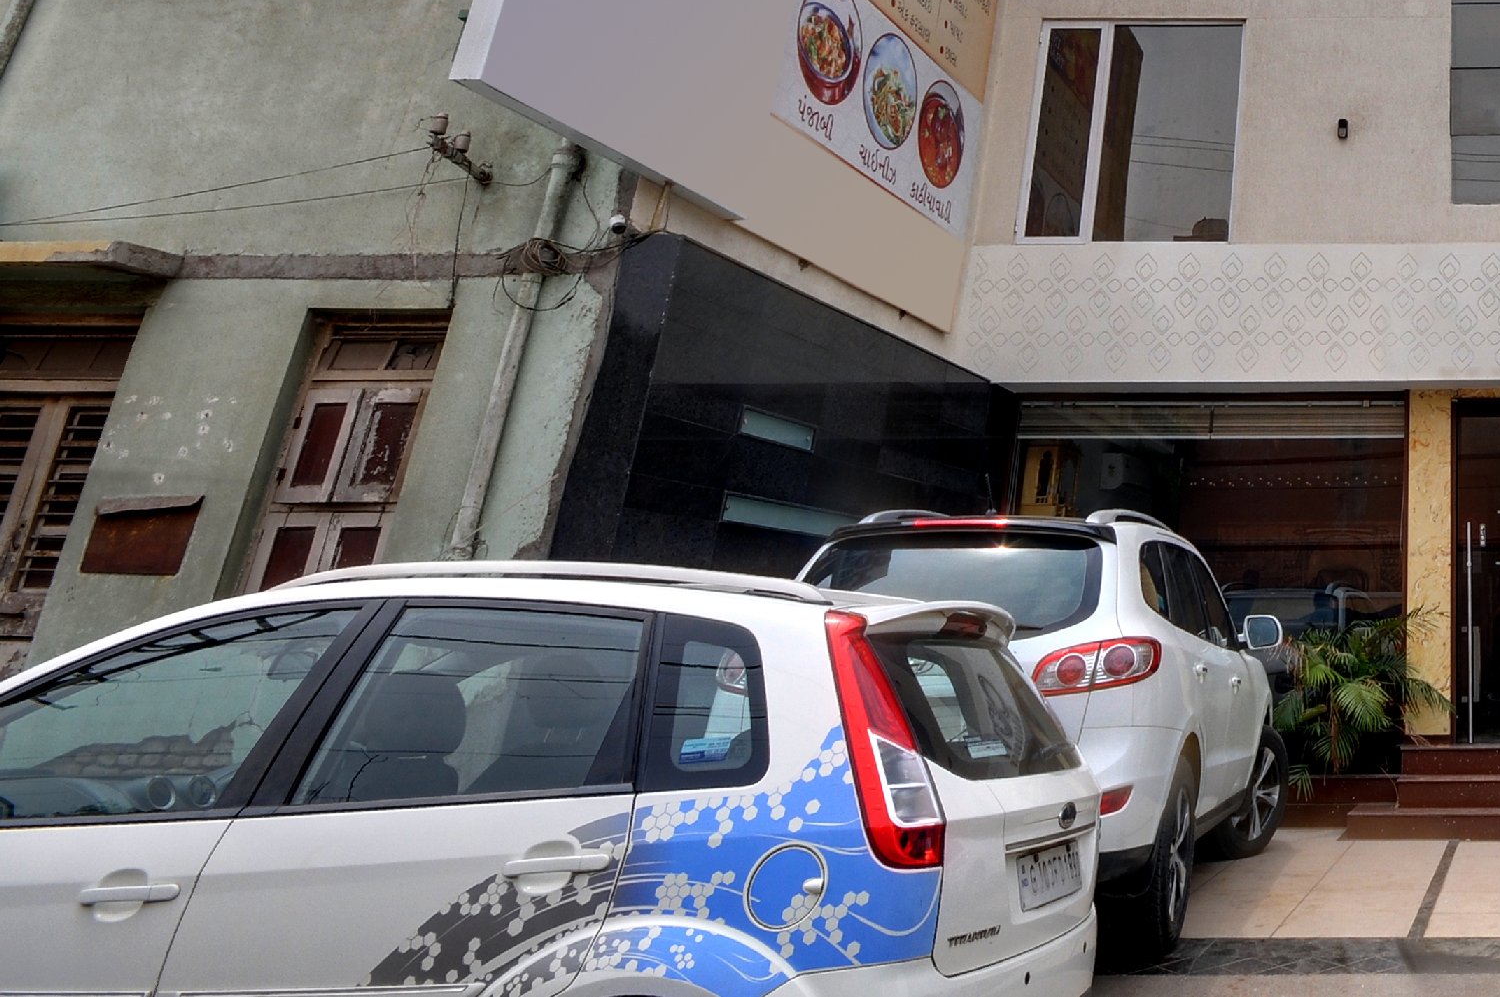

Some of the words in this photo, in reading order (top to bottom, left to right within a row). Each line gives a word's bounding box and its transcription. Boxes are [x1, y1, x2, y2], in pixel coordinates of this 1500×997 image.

[798, 95, 834, 141] પંજાબી
[858, 144, 897, 185] ચાઈનીઝ
[910, 181, 952, 224] કાઠીયાવાડી
